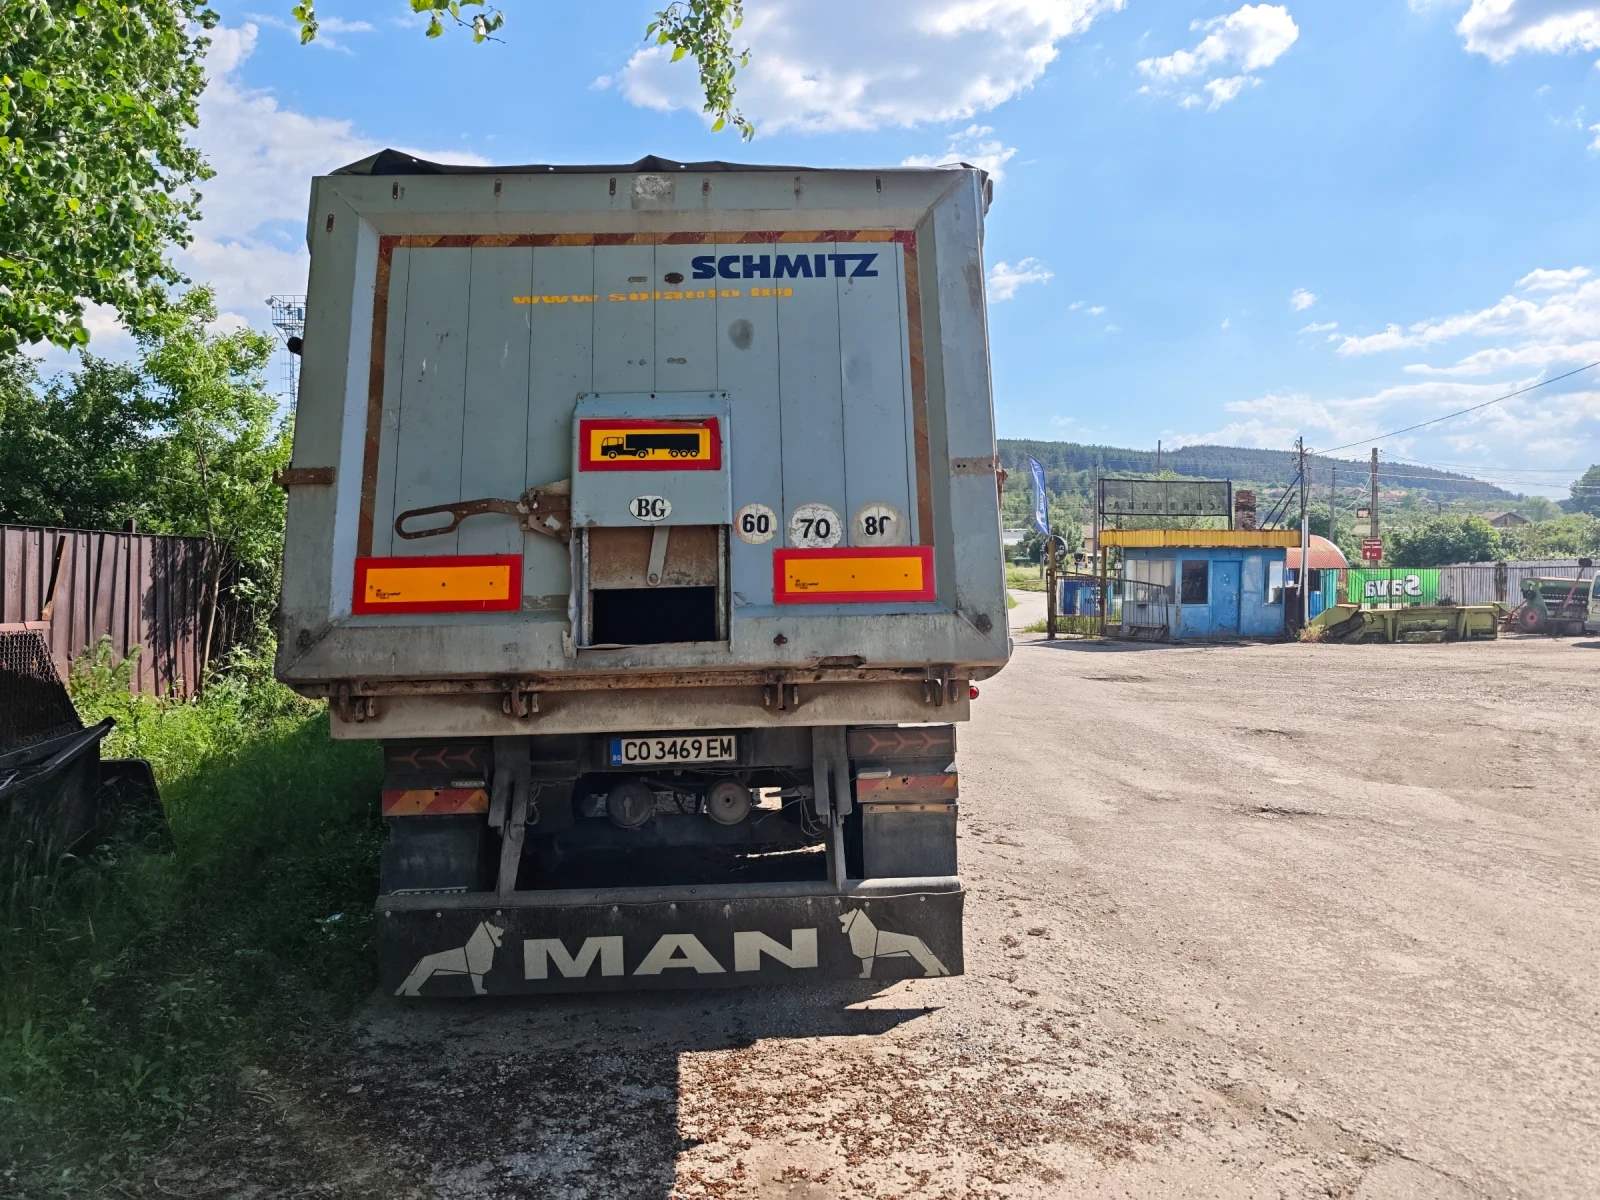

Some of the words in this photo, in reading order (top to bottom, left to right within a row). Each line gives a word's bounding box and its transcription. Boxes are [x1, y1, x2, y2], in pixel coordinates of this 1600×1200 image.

[691, 253, 879, 280] SCHMITZ
[636, 498, 667, 518] BG
[742, 513, 770, 533] 60
[800, 518, 831, 539] 70
[655, 739, 703, 760] 3469
[706, 738, 733, 758] EM
[523, 928, 818, 980] MAN
